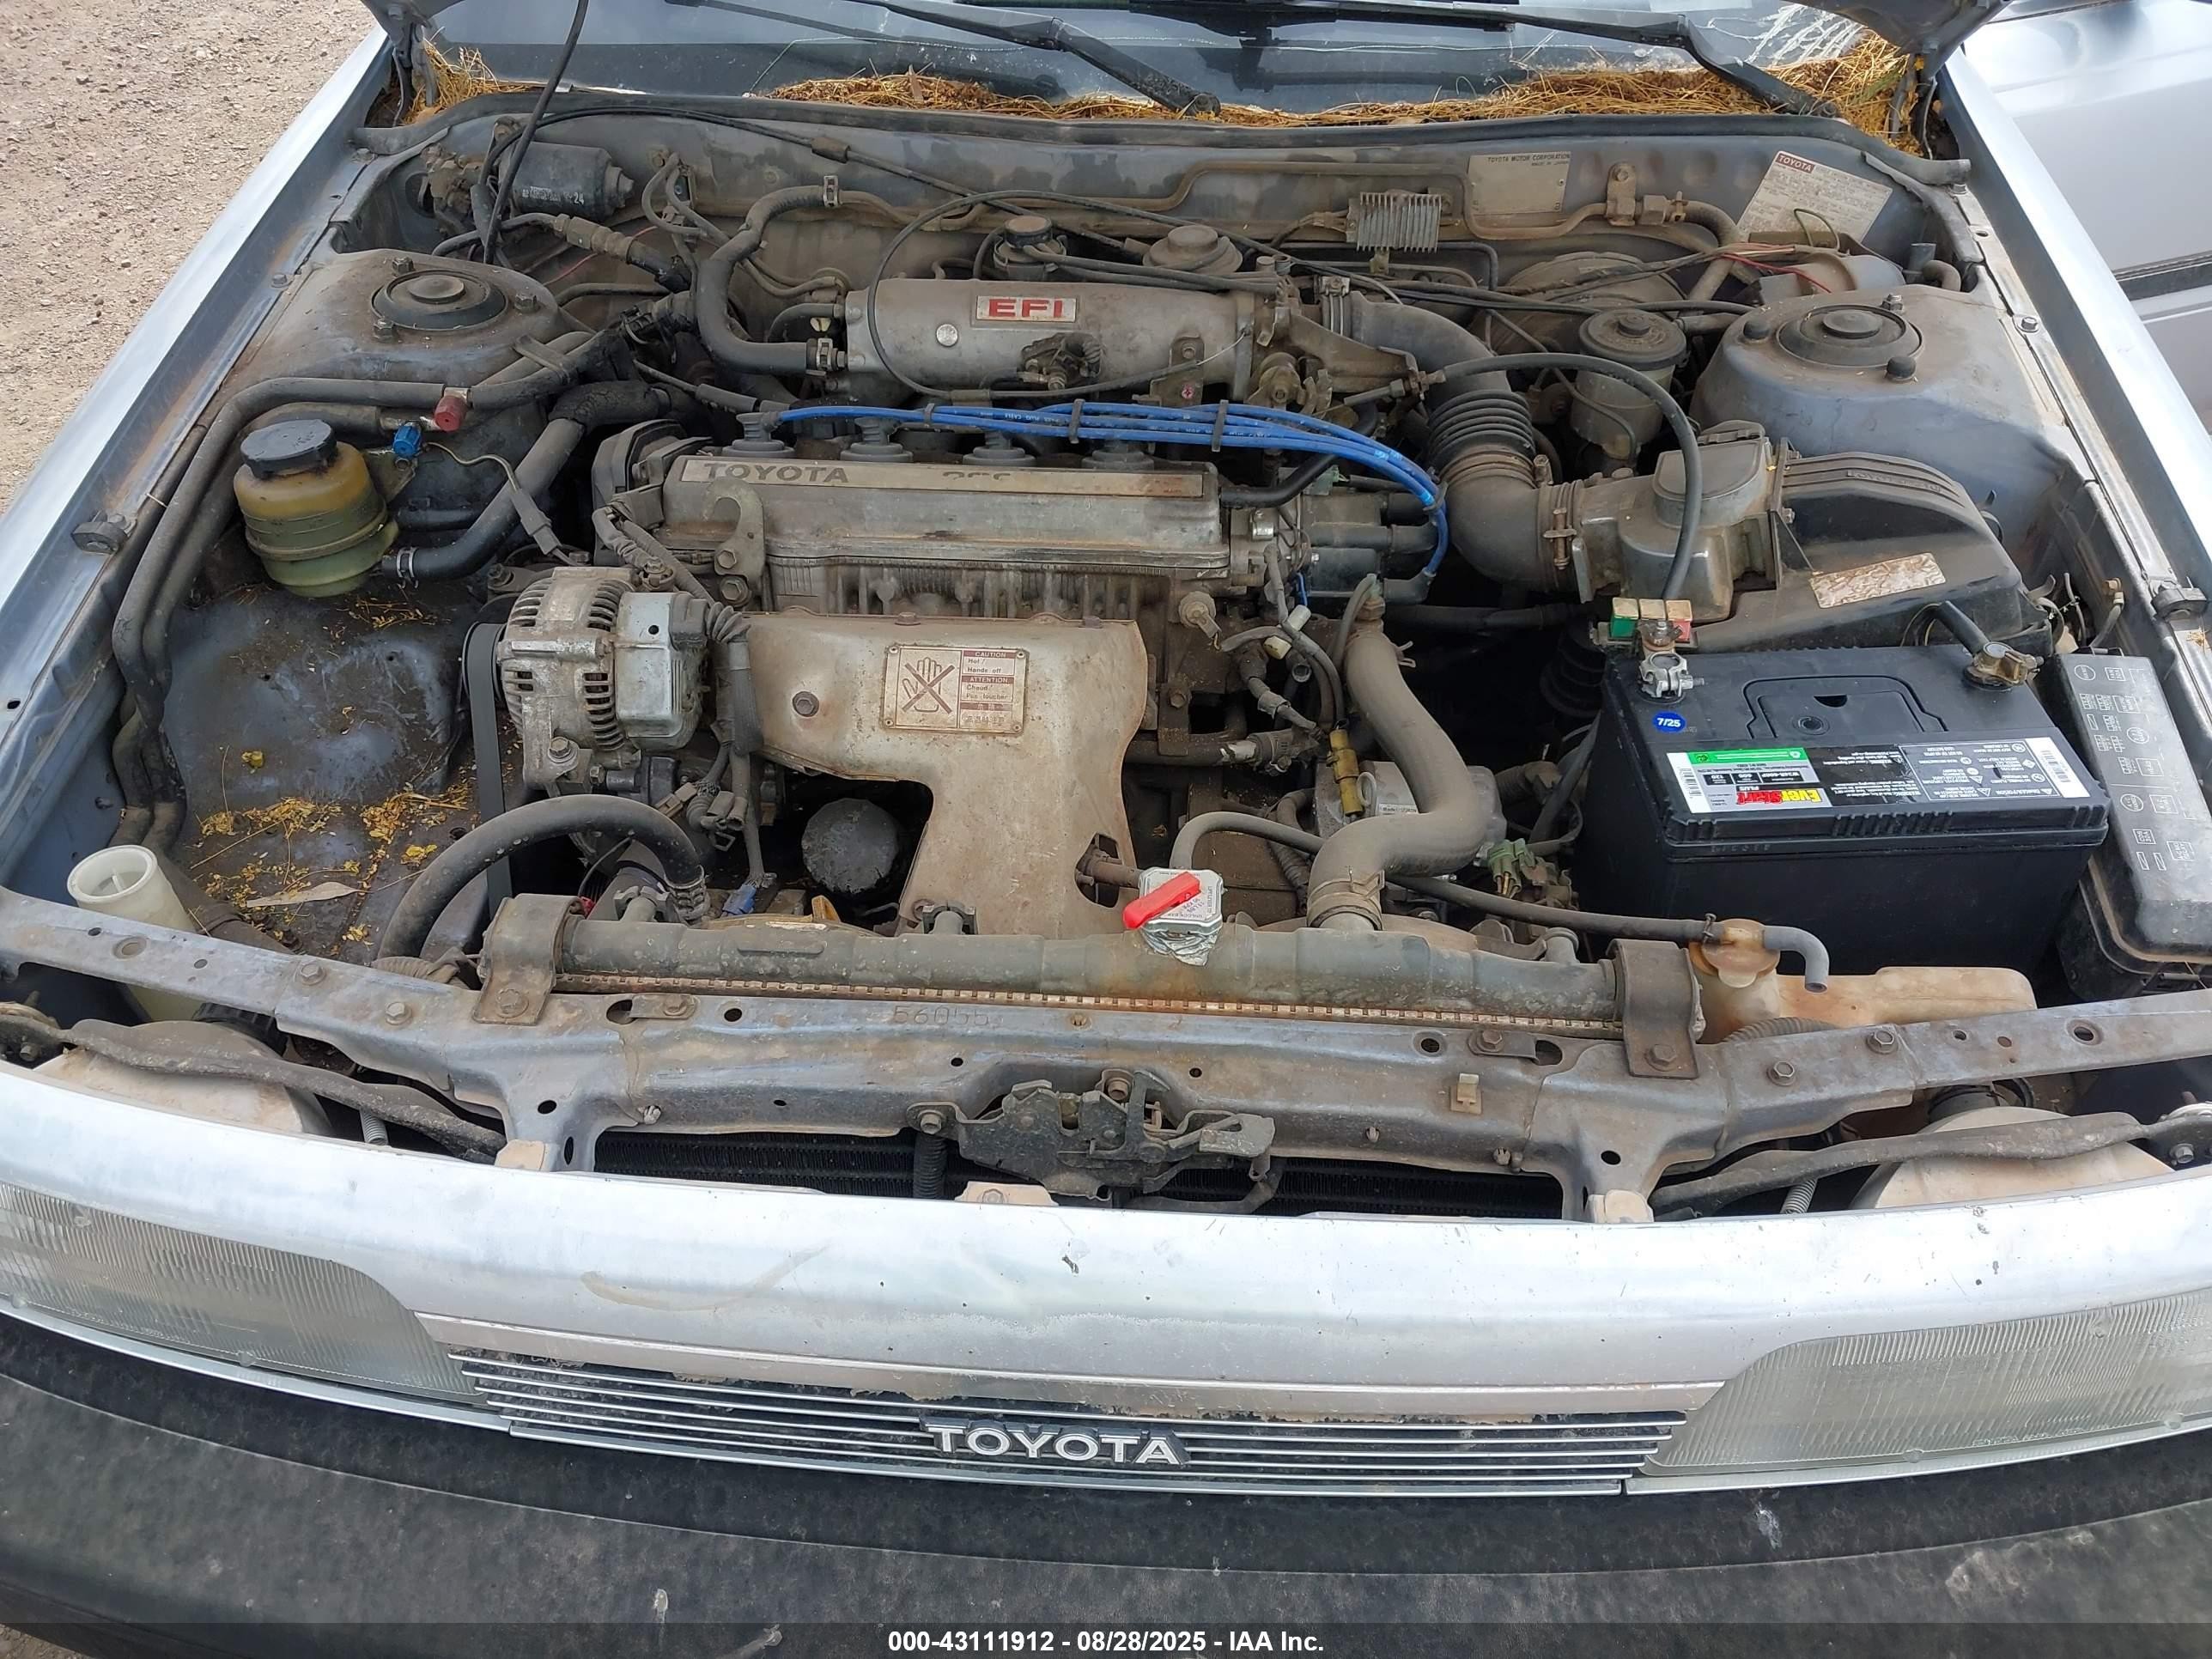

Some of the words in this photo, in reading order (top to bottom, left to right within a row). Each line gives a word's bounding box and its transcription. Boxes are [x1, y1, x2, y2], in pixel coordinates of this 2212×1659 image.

[1778, 155, 1812, 172] TOYOTA
[988, 299, 1063, 319] EFI
[703, 462, 849, 483] TOYOTA
[1657, 717, 1680, 728] 7/25
[1736, 788, 1822, 805] EverStart
[926, 1425, 1180, 1465] TOYOTA
